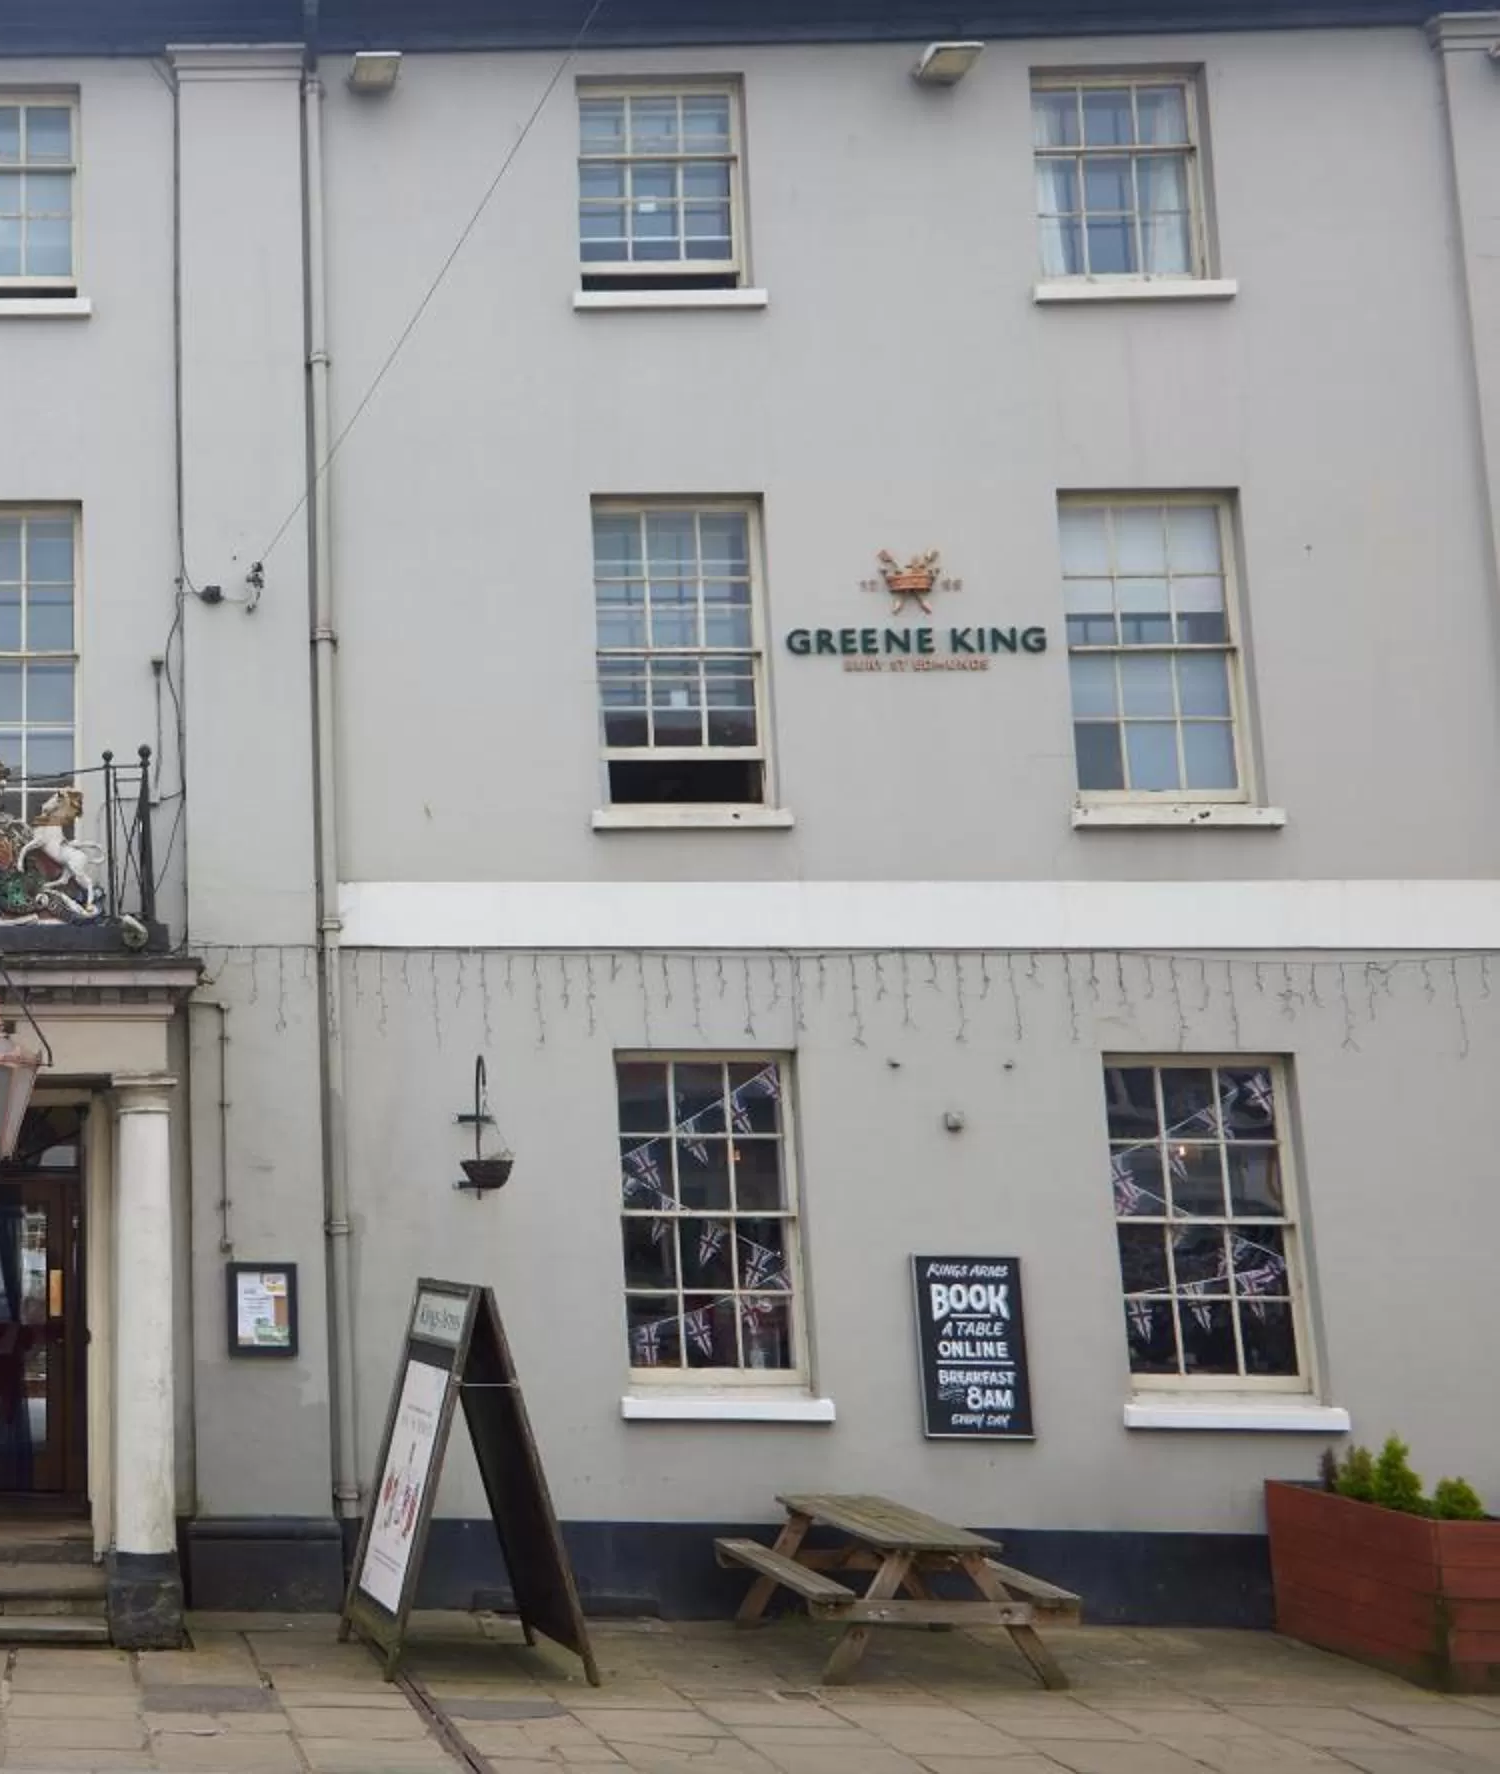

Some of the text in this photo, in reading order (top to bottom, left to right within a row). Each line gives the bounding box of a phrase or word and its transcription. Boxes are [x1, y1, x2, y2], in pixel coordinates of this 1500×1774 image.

[786, 626, 1048, 656] GREENE KING
[927, 1263, 967, 1278] KINGS
[930, 1283, 1011, 1322] BOOK
[941, 1321, 1005, 1337] A TABLE
[937, 1340, 1009, 1358] ONLINE
[938, 1369, 1016, 1386] BREAKFAST
[966, 1385, 1015, 1411] 8AM
